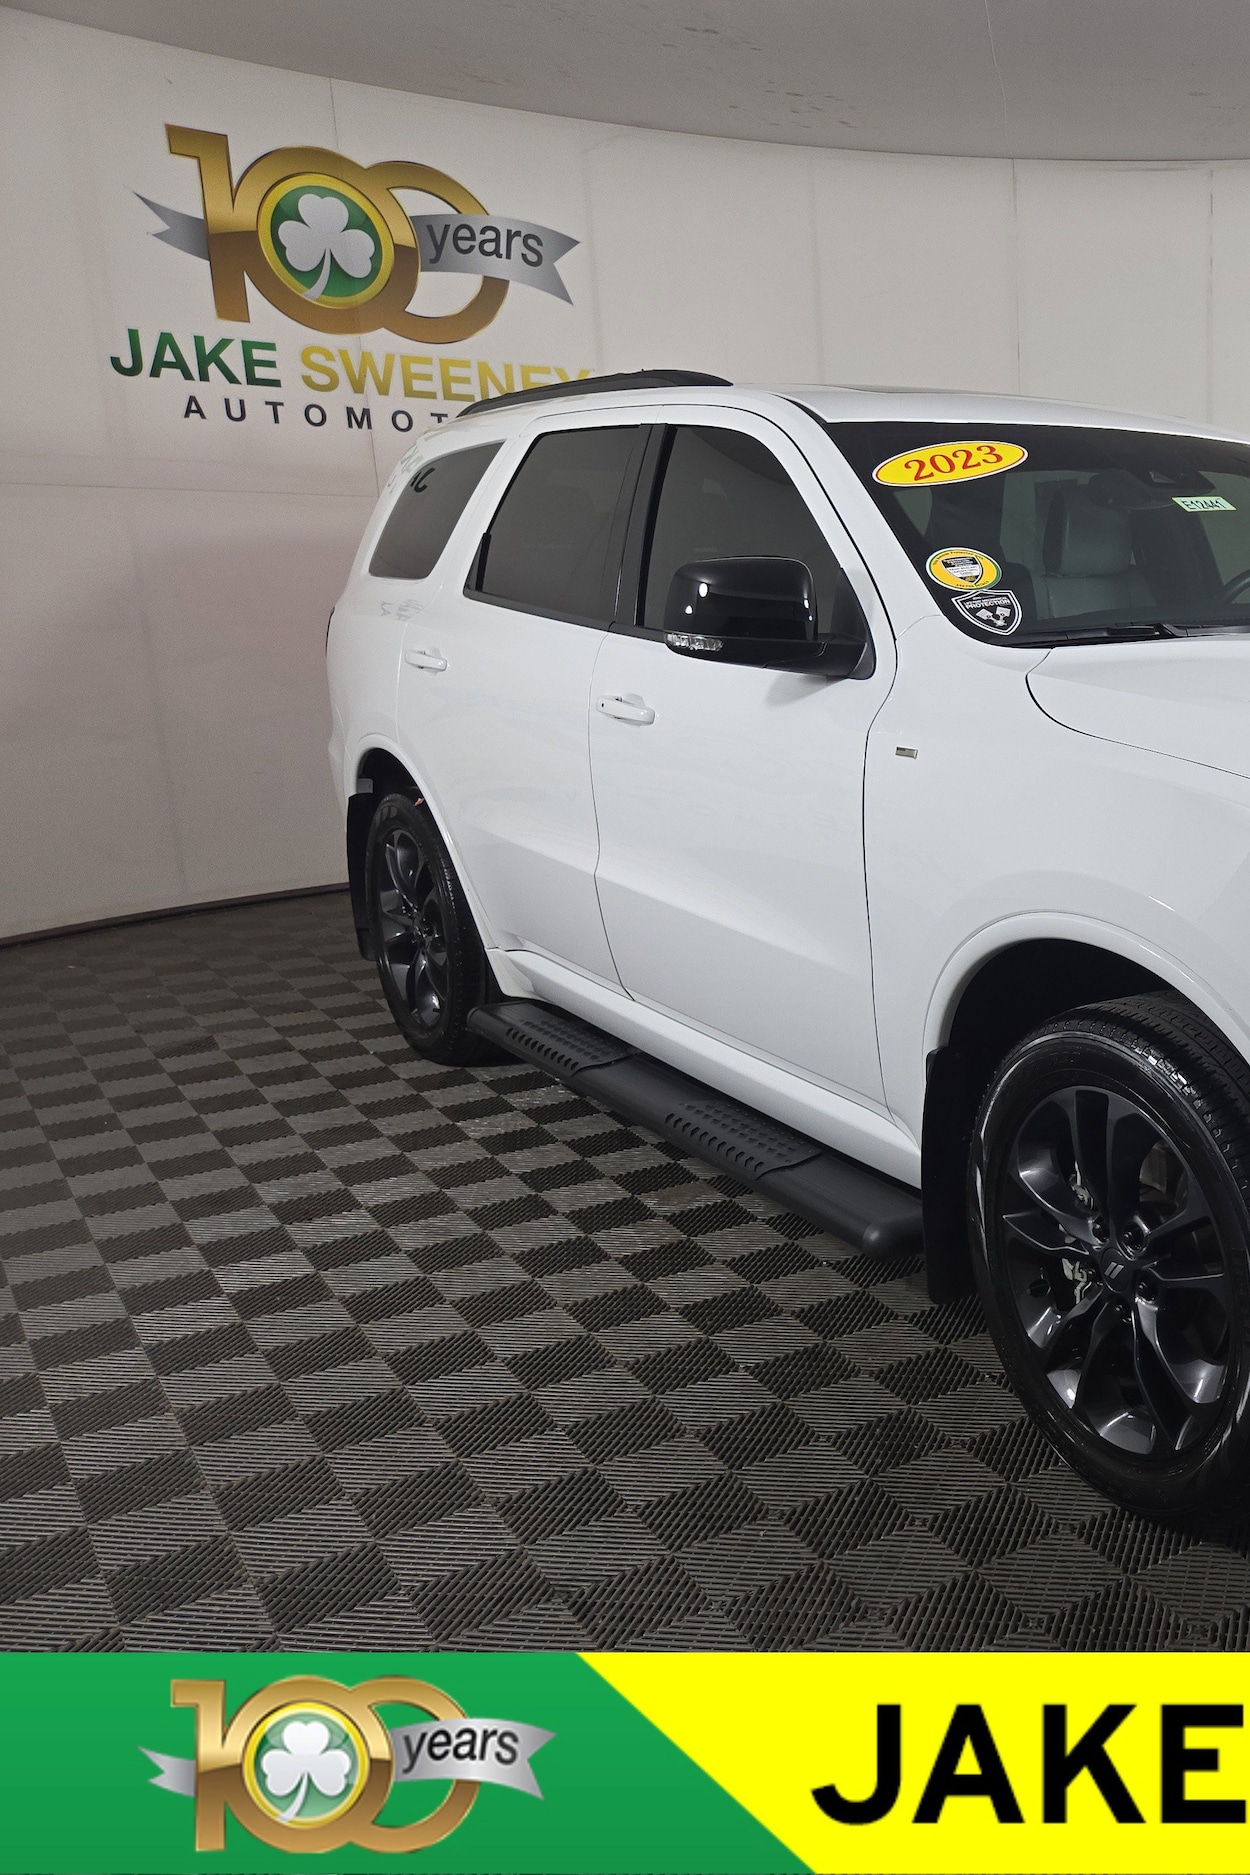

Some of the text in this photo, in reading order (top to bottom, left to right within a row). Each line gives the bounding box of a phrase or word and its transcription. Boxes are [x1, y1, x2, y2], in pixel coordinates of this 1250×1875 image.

[426, 218, 545, 266] years
[110, 328, 282, 388] JAKE
[904, 445, 1003, 481] 2023
